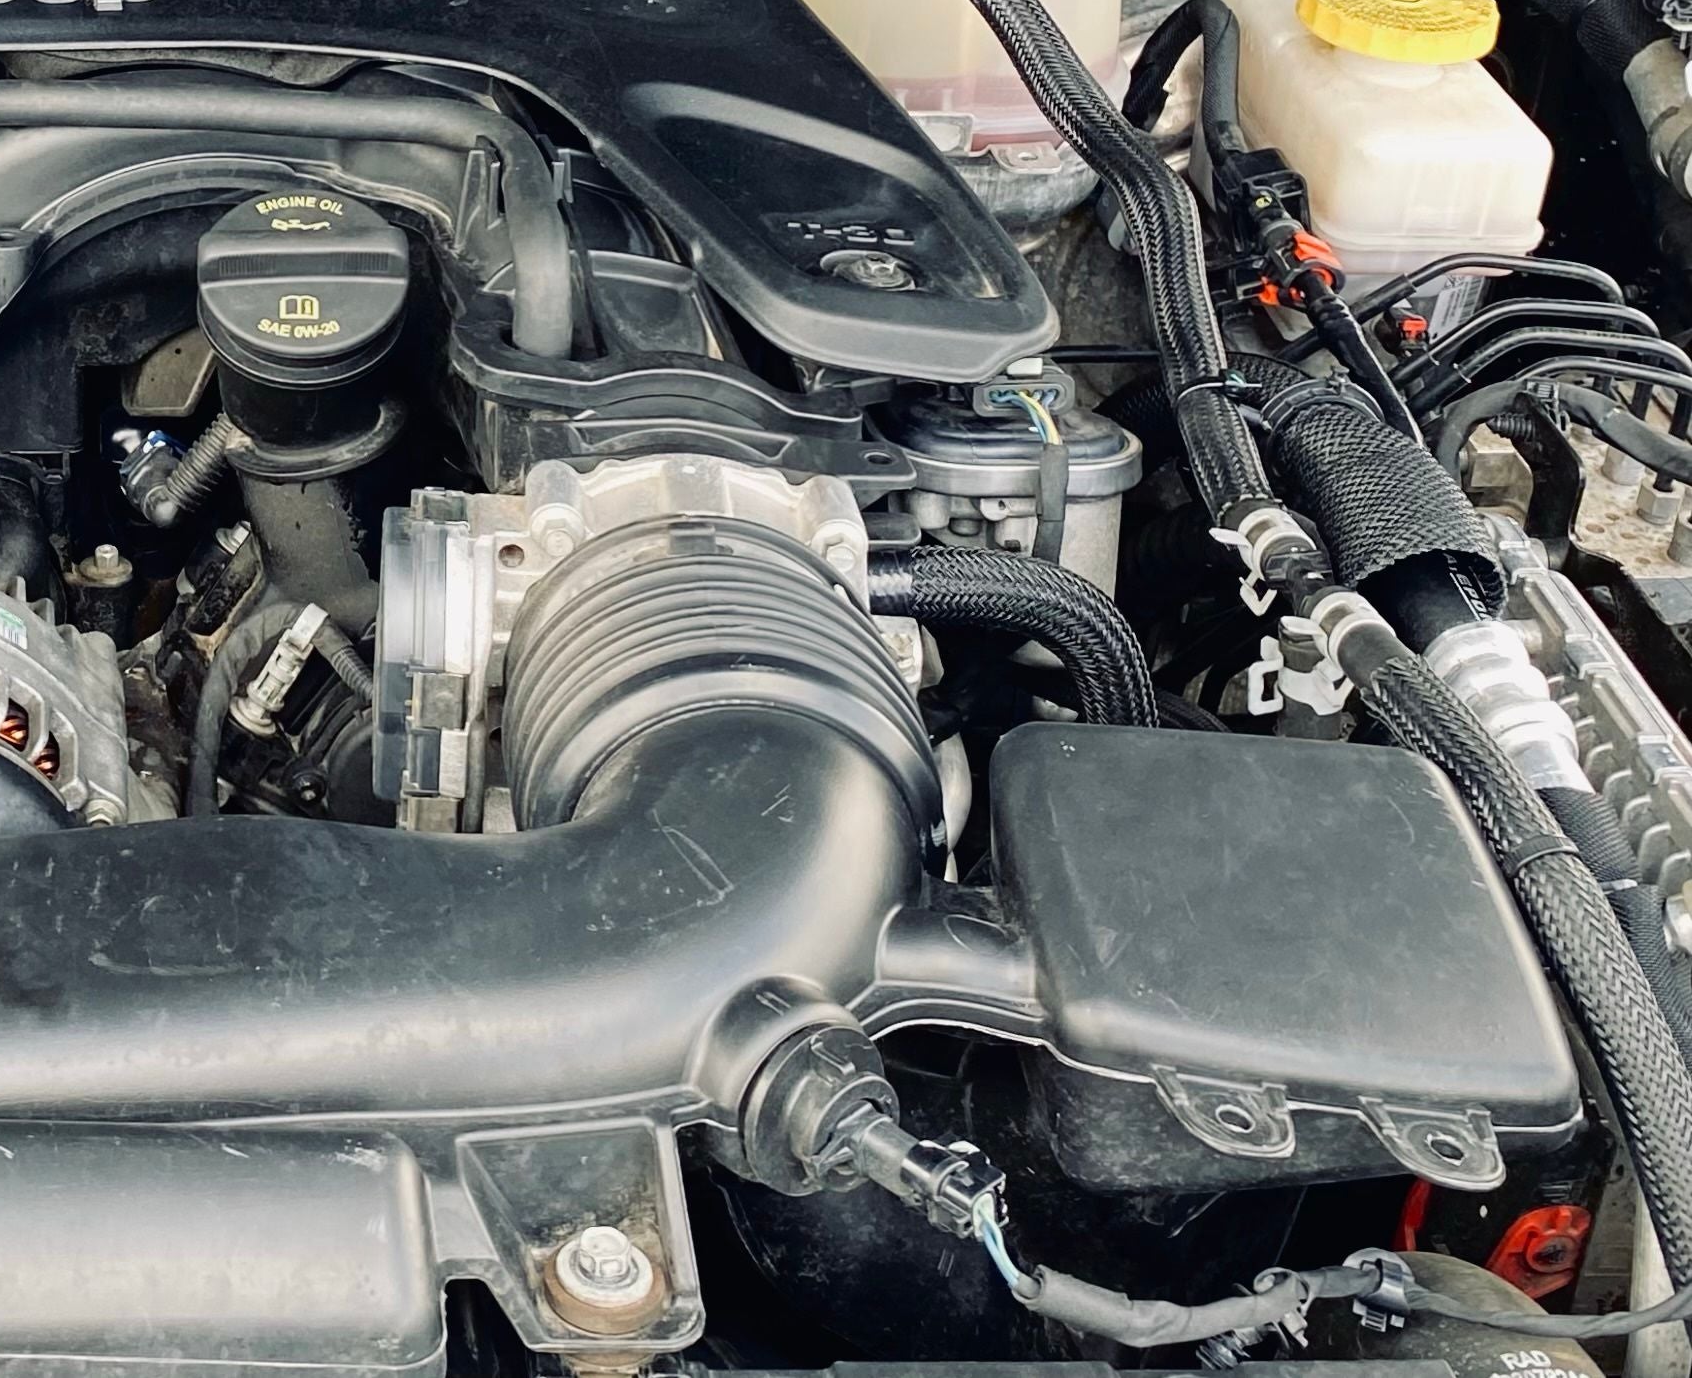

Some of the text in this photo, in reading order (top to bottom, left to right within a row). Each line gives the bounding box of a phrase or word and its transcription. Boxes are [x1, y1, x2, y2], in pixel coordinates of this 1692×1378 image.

[255, 196, 345, 216] ENGINE OIL
[257, 319, 341, 339] SAE 0W-20
[1500, 1350, 1552, 1370] RAD
